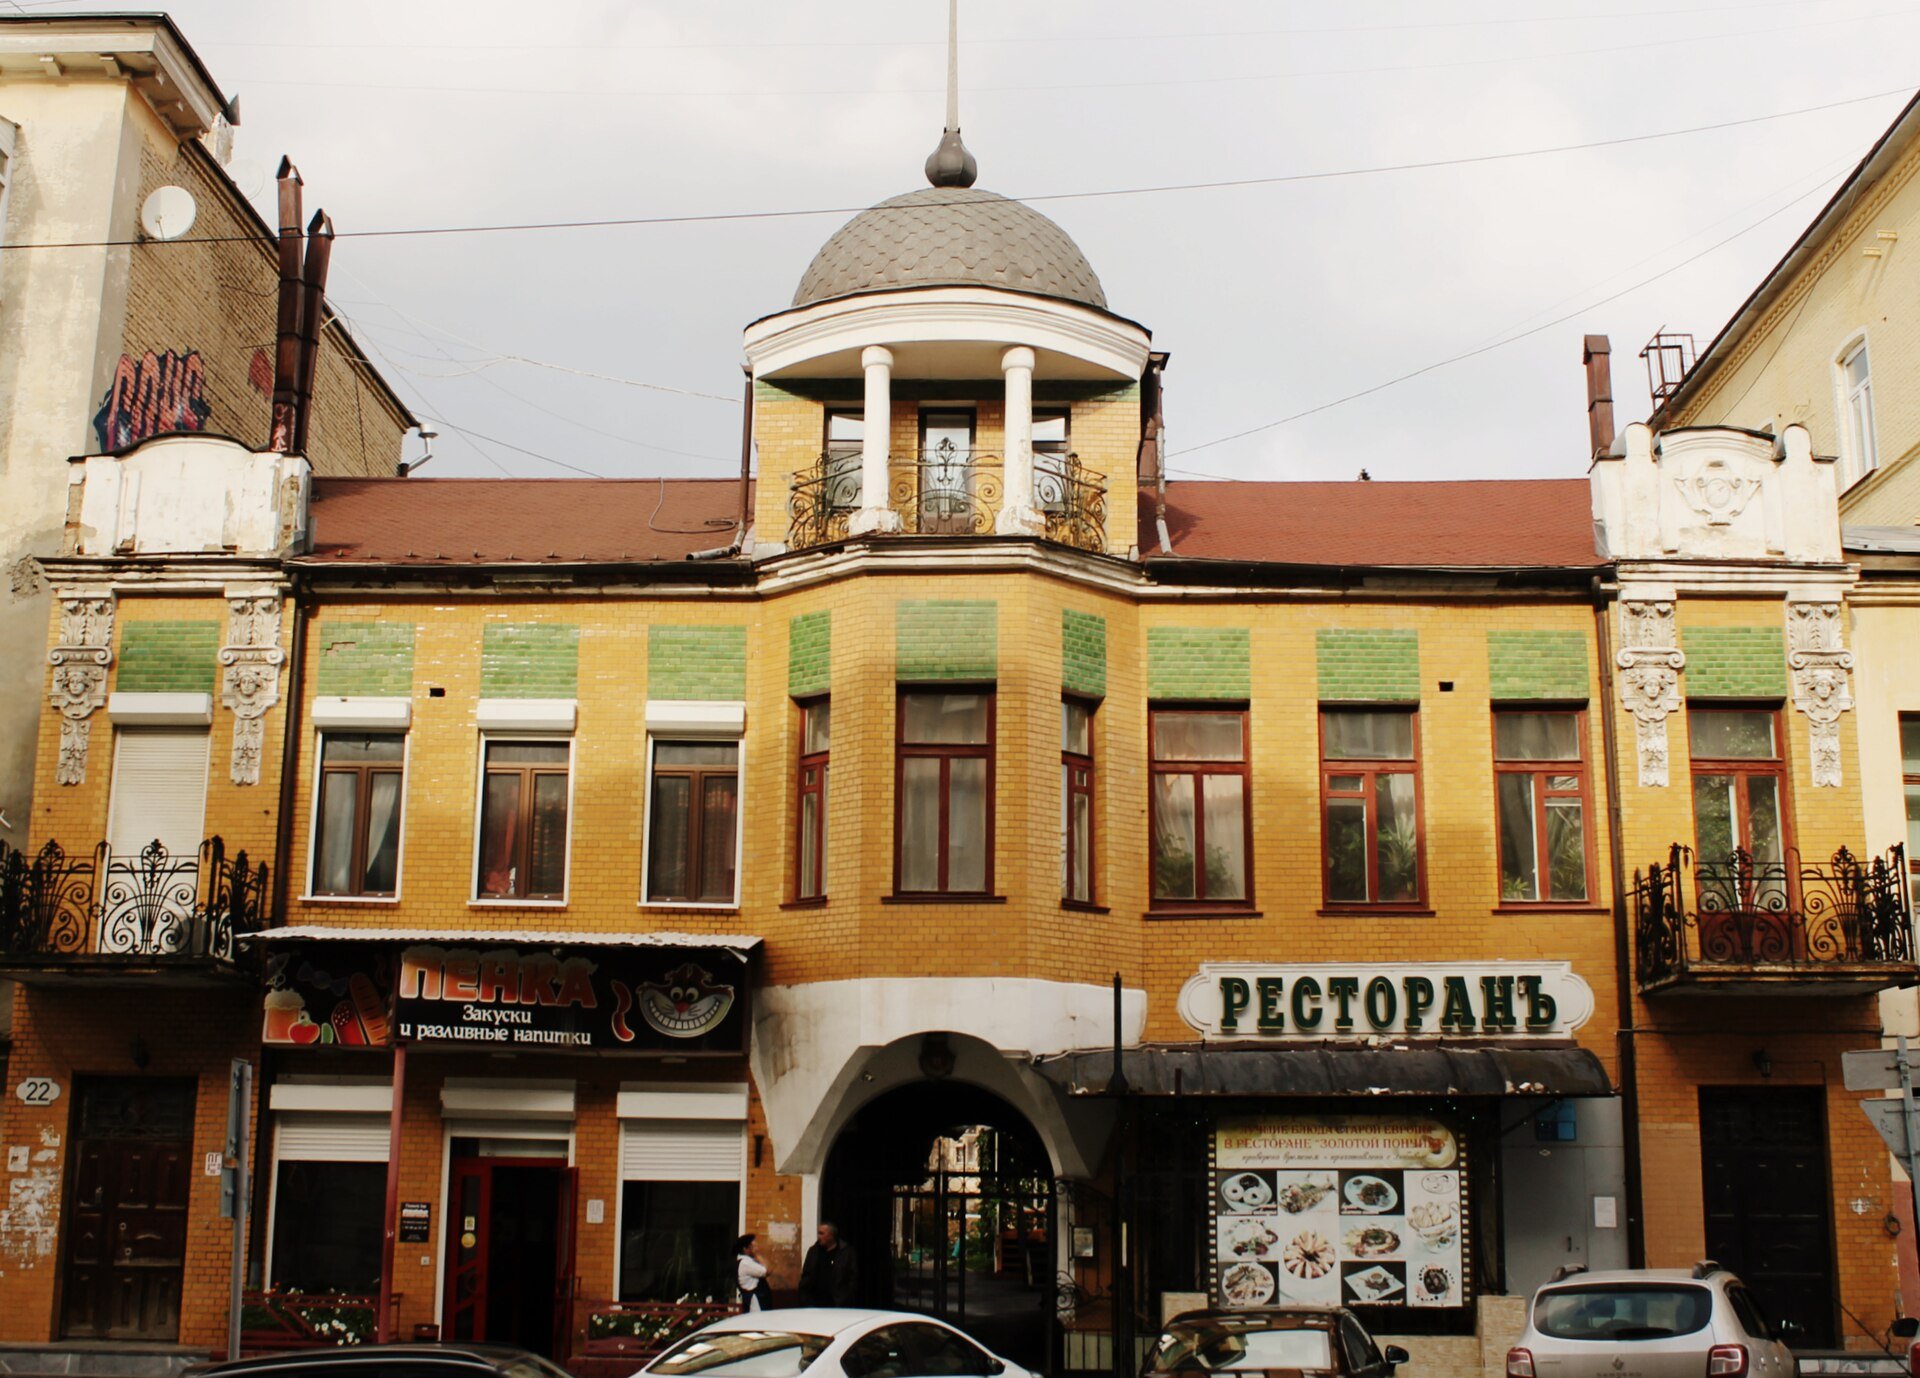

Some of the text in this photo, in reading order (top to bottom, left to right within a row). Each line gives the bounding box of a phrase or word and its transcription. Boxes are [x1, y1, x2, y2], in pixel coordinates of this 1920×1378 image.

[399, 945, 599, 1008] ПЕНКА
[1219, 975, 1557, 1031] РЕСТОРАНЪ
[462, 1004, 532, 1025] Закуски
[399, 1023, 592, 1045] и разливные напитки
[26, 1081, 50, 1101] 22
[1224, 1138, 1232, 1149] В
[1237, 1138, 1312, 1149] РЕСТОРАНЕ
